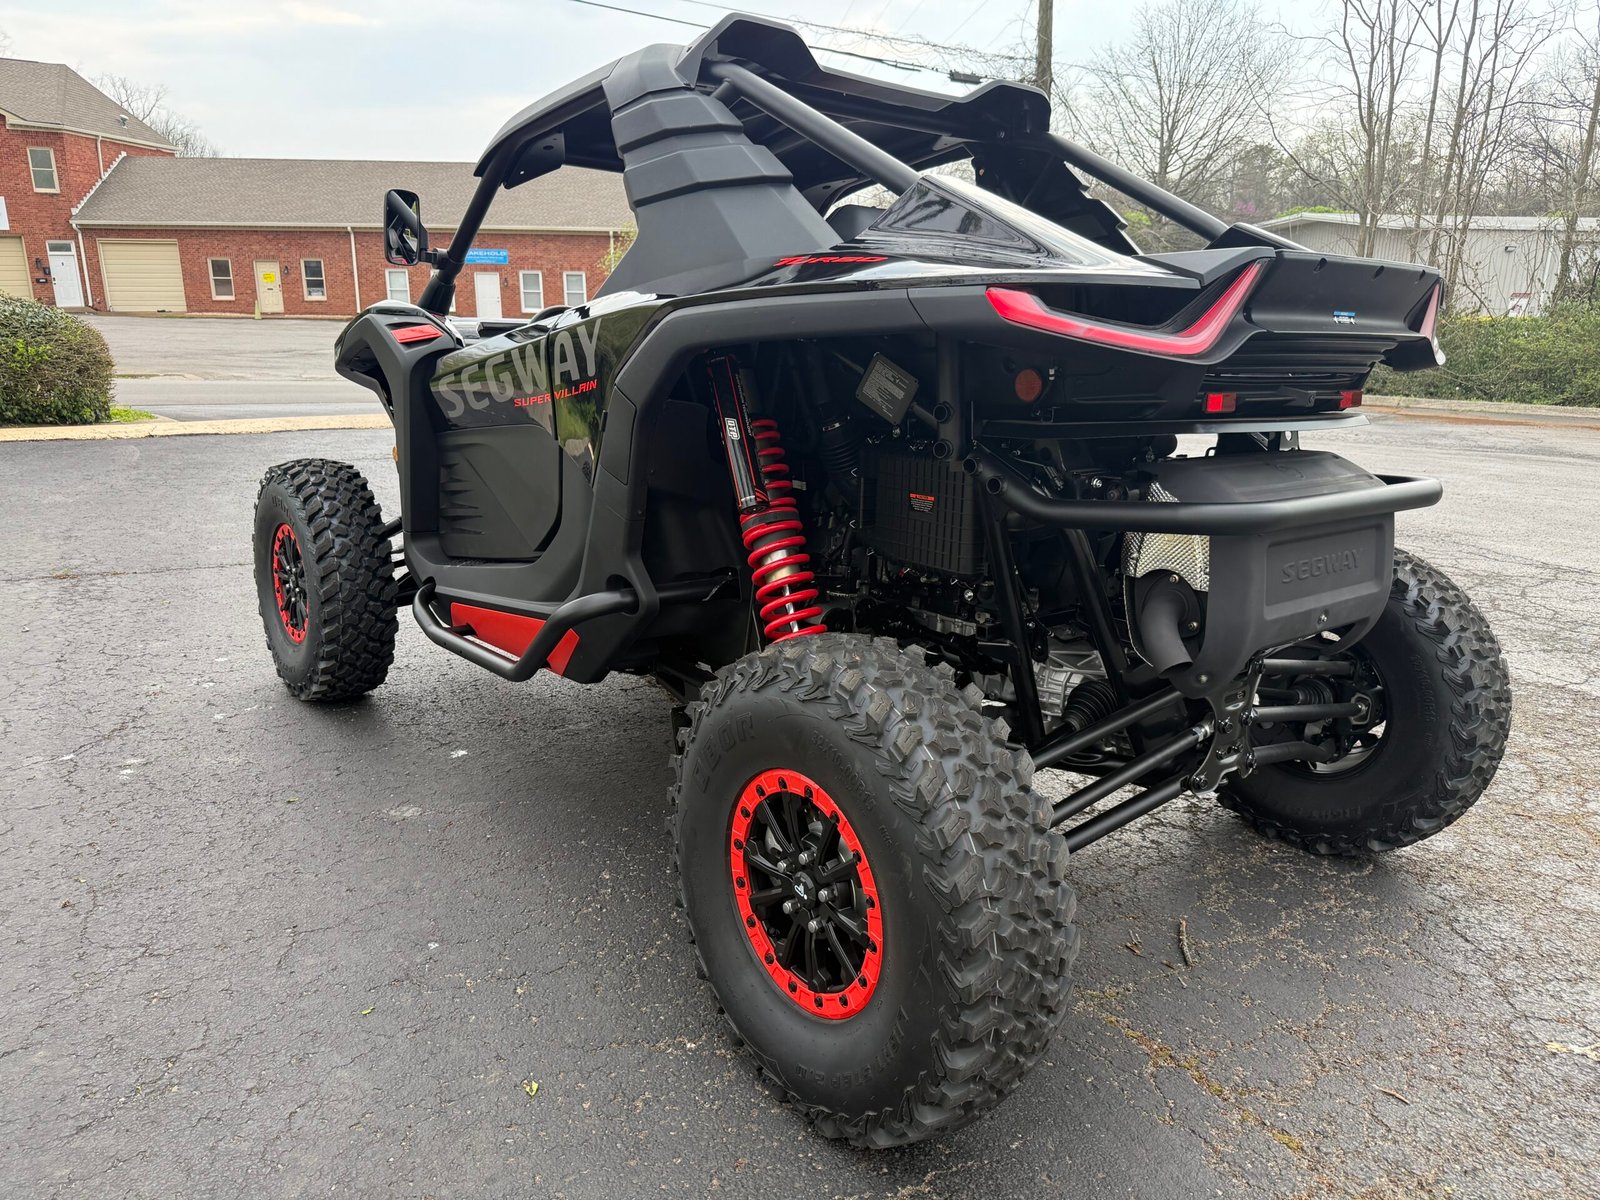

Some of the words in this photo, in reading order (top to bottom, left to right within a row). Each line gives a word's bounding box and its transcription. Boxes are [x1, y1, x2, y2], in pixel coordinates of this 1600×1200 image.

[773, 255, 889, 266] TURBO
[438, 318, 602, 418] SEGWAY
[514, 393, 551, 407] SUPER
[554, 379, 598, 400] VILLAIN
[1281, 549, 1359, 584] SEGWAY
